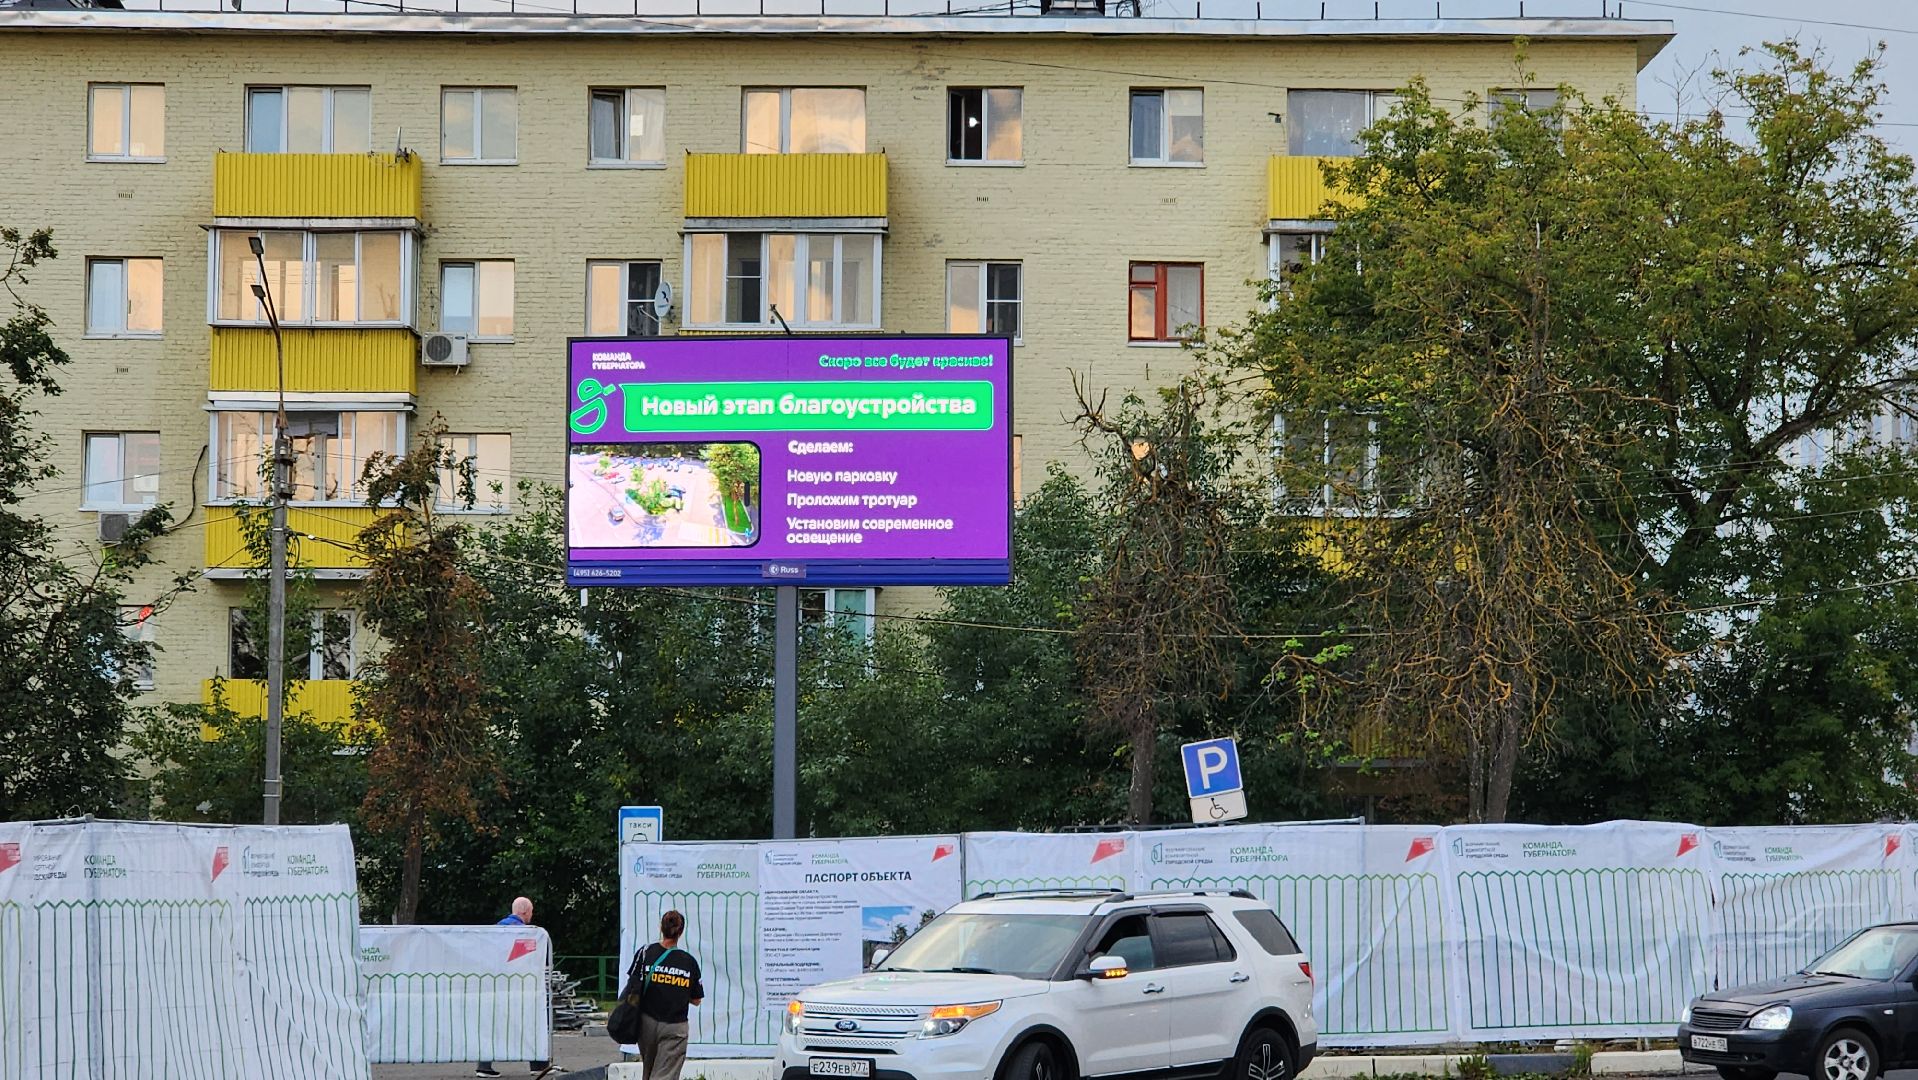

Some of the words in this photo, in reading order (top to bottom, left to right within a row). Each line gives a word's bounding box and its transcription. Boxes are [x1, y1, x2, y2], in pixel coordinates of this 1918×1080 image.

[592, 352, 632, 361] КОМАНДА
[818, 354, 862, 370] Скоро
[889, 353, 930, 369] будет
[932, 354, 993, 370] красиво!
[592, 361, 646, 370] ГУБЕРНАТОРА
[641, 394, 719, 416] Новый
[722, 398, 774, 415] этап
[779, 393, 976, 419] благоустройства
[788, 440, 854, 455] Сделаем:
[787, 469, 832, 485] Новую
[834, 471, 898, 485] парковку
[786, 493, 859, 509] Проложим
[861, 495, 918, 509] тротуар
[786, 517, 860, 530] Установим
[862, 518, 954, 532] современное
[786, 532, 863, 545] освещение
[591, 568, 622, 577] 626-5202
[780, 566, 799, 574] Russ
[1197, 746, 1228, 790] P
[1230, 845, 1273, 855] КОМАНДА
[1522, 841, 1563, 849] КОМАНДА
[1230, 854, 1289, 863] ГУБЕРНАТОРА
[1523, 849, 1577, 858] ГУБЕРНАТОРА
[287, 854, 316, 864] КОМАНДА
[287, 866, 329, 876] ГУБЕРНАТОРА
[697, 863, 737, 871] КОМАНДА
[696, 871, 751, 879] ГУБЕРНАТОРА
[804, 872, 859, 883] ПАСПОРТ
[860, 871, 912, 882] ОБЪЕКТА
[648, 972, 690, 988] ОССИИ
[851, 1062, 867, 1072] 977
